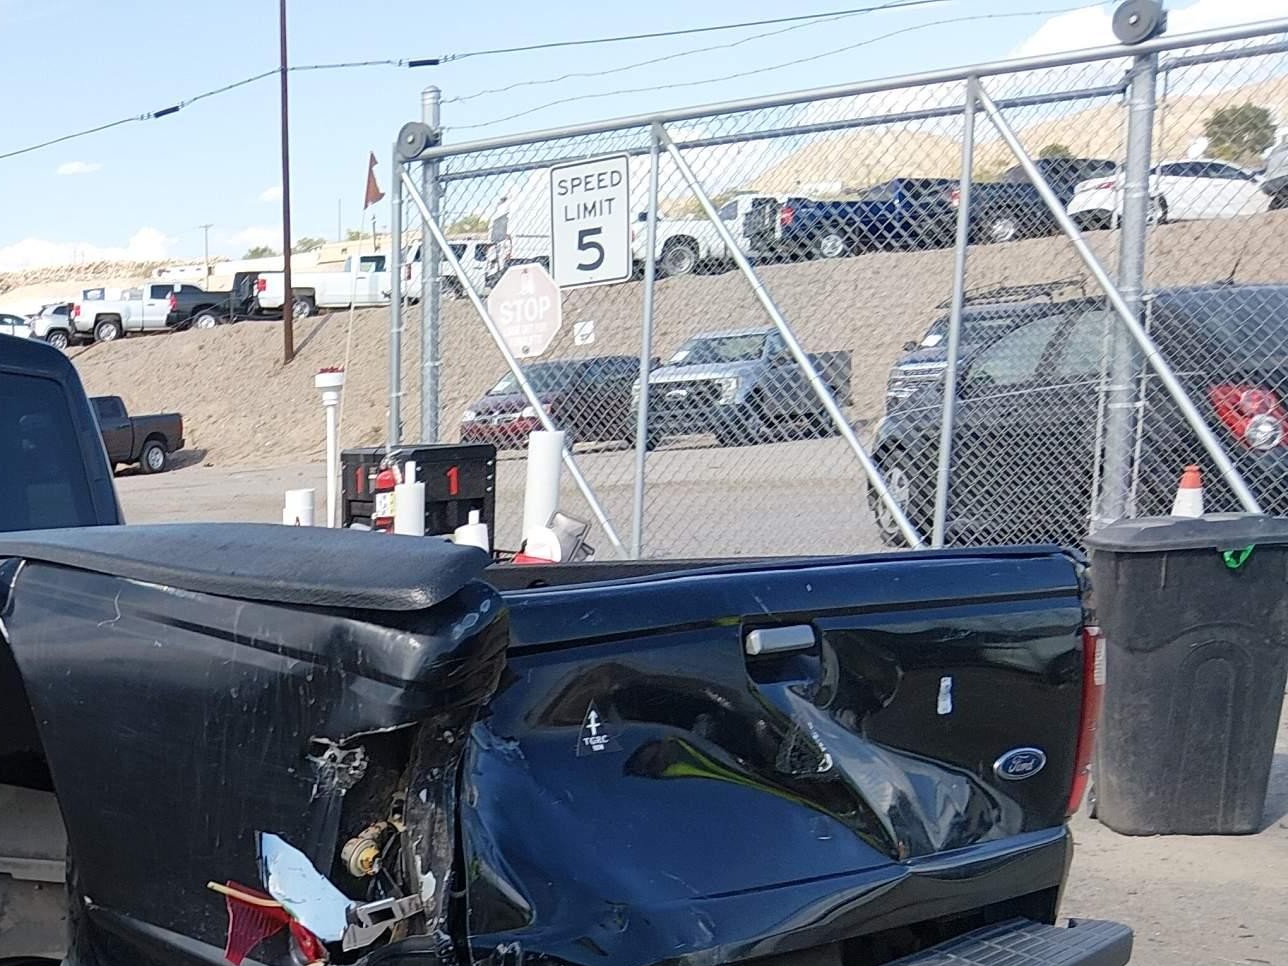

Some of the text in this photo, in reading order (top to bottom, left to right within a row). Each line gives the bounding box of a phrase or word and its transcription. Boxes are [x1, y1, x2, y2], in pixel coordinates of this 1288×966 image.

[557, 170, 623, 197] SPEED
[564, 198, 616, 222] LIMIT
[576, 226, 605, 271] 5
[500, 295, 551, 324] STOP
[445, 465, 459, 495] 1
